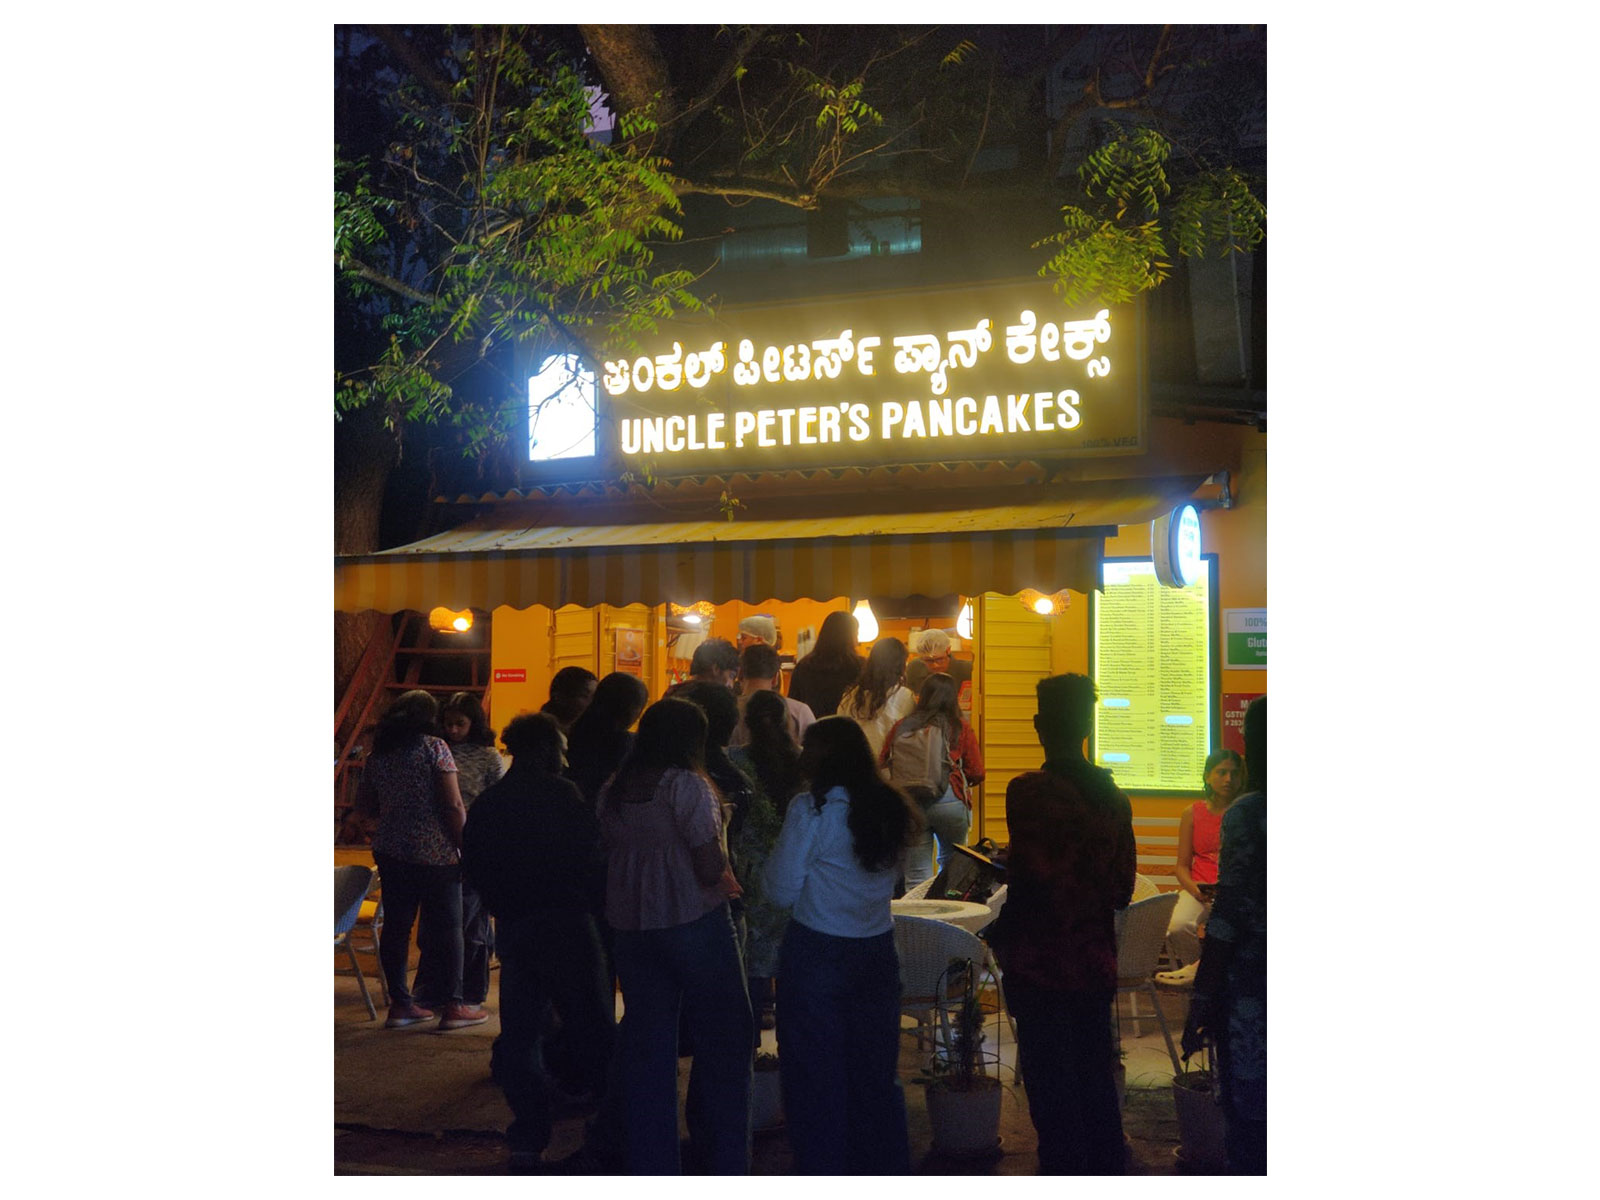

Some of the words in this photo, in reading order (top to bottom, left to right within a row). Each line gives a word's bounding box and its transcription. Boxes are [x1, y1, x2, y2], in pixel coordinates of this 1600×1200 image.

[603, 341, 727, 395] ಅಂಕಲ್
[733, 328, 882, 387] ಪೀಟರ್ಸ್
[893, 317, 994, 396] ಪ್ಯಾನ್
[1005, 308, 1113, 379] ಕೇಕ್ಸ್
[621, 411, 728, 455] UNCLE
[735, 401, 872, 449] PETER'S
[881, 388, 1083, 440] PANCAKES
[1082, 437, 1111, 449] 100%
[1114, 435, 1138, 448] VEG
